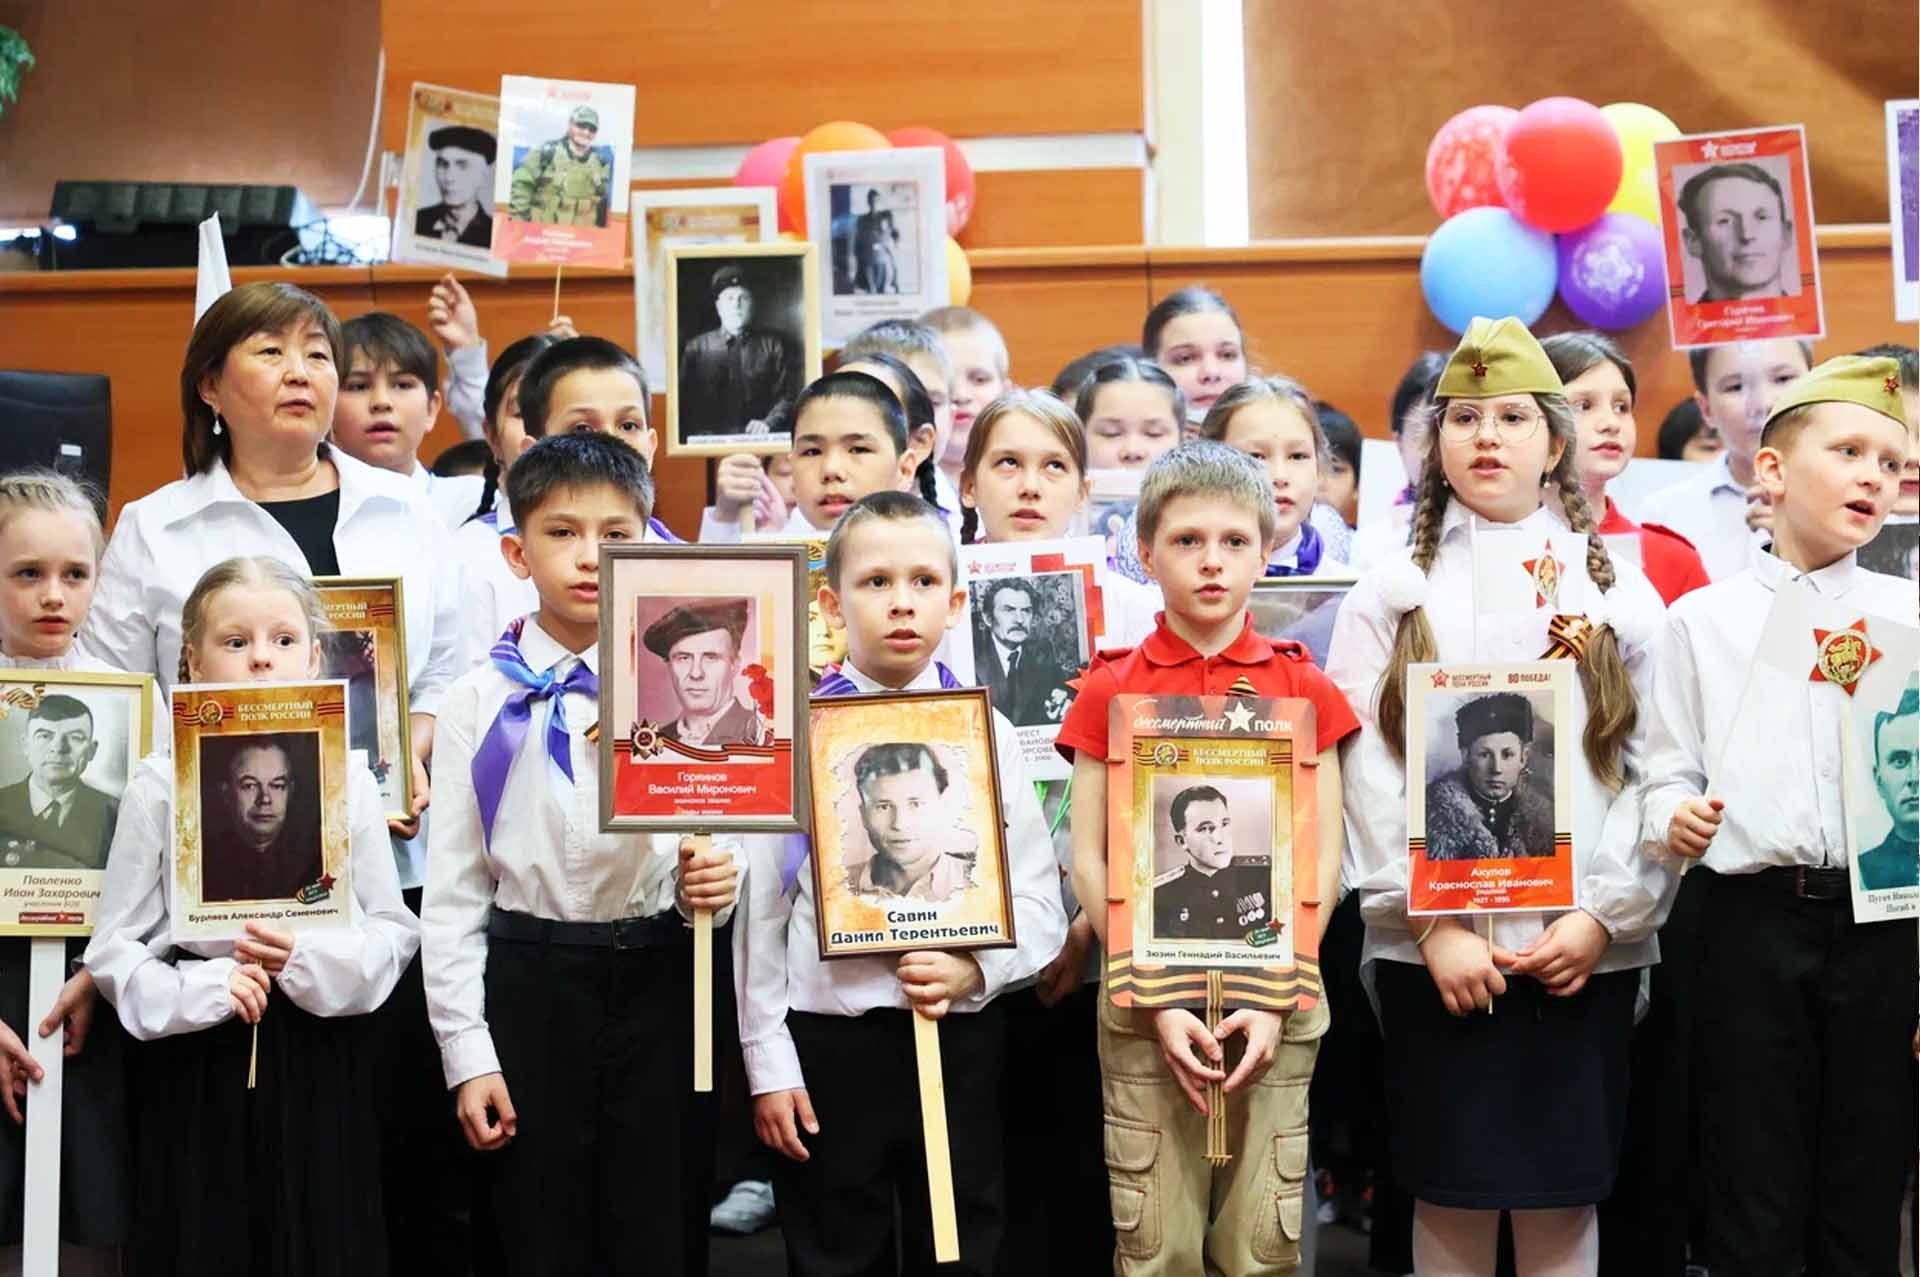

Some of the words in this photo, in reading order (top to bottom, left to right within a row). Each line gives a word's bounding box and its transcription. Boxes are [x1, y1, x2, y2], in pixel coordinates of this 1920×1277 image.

[237, 700, 314, 712] БЕССМЕРТНЫЙ
[240, 711, 269, 721] ПОЛК
[270, 709, 310, 720] РОССИИ
[648, 783, 694, 795] Василий
[696, 784, 757, 796] Миронович
[23, 875, 83, 886] Павленко
[1429, 880, 1496, 892] Краснослав
[1498, 878, 1554, 889] Иванович
[4, 888, 35, 897] Иван
[188, 913, 229, 924] Бурляев
[231, 911, 284, 921] Александр
[285, 907, 339, 918] Семенович
[887, 911, 938, 923] Савин
[831, 931, 885, 945] Данил
[889, 924, 999, 941] Терентьевич
[1145, 950, 1176, 958] Зюзин
[1177, 950, 1223, 959] Геннадий
[1224, 951, 1281, 960] Васильевич
